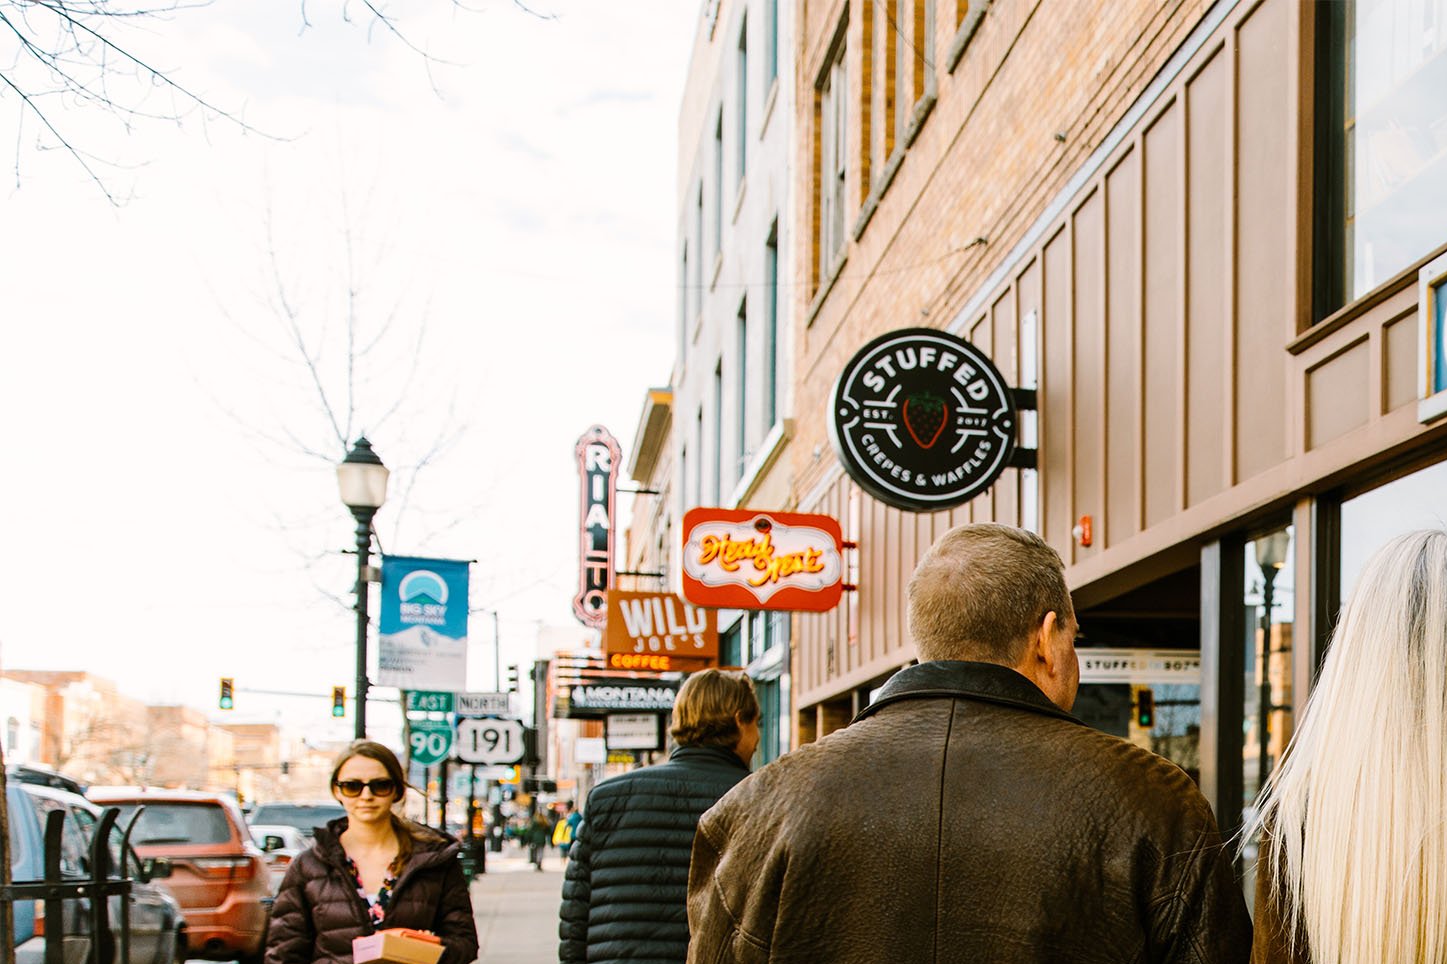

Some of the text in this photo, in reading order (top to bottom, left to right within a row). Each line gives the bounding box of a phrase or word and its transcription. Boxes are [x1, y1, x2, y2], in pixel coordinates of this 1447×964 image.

[862, 347, 989, 400] STUFFED
[861, 434, 992, 487] CREPES & WAFFLES
[584, 444, 611, 618] RIALTO
[423, 604, 447, 618] SKY
[619, 597, 707, 638] WILD
[611, 653, 670, 670] COFFEE
[407, 691, 447, 709] EAST
[460, 697, 507, 708] NORTH
[585, 687, 676, 701] MONTANA
[411, 732, 446, 757] 90
[472, 729, 510, 753] 191
